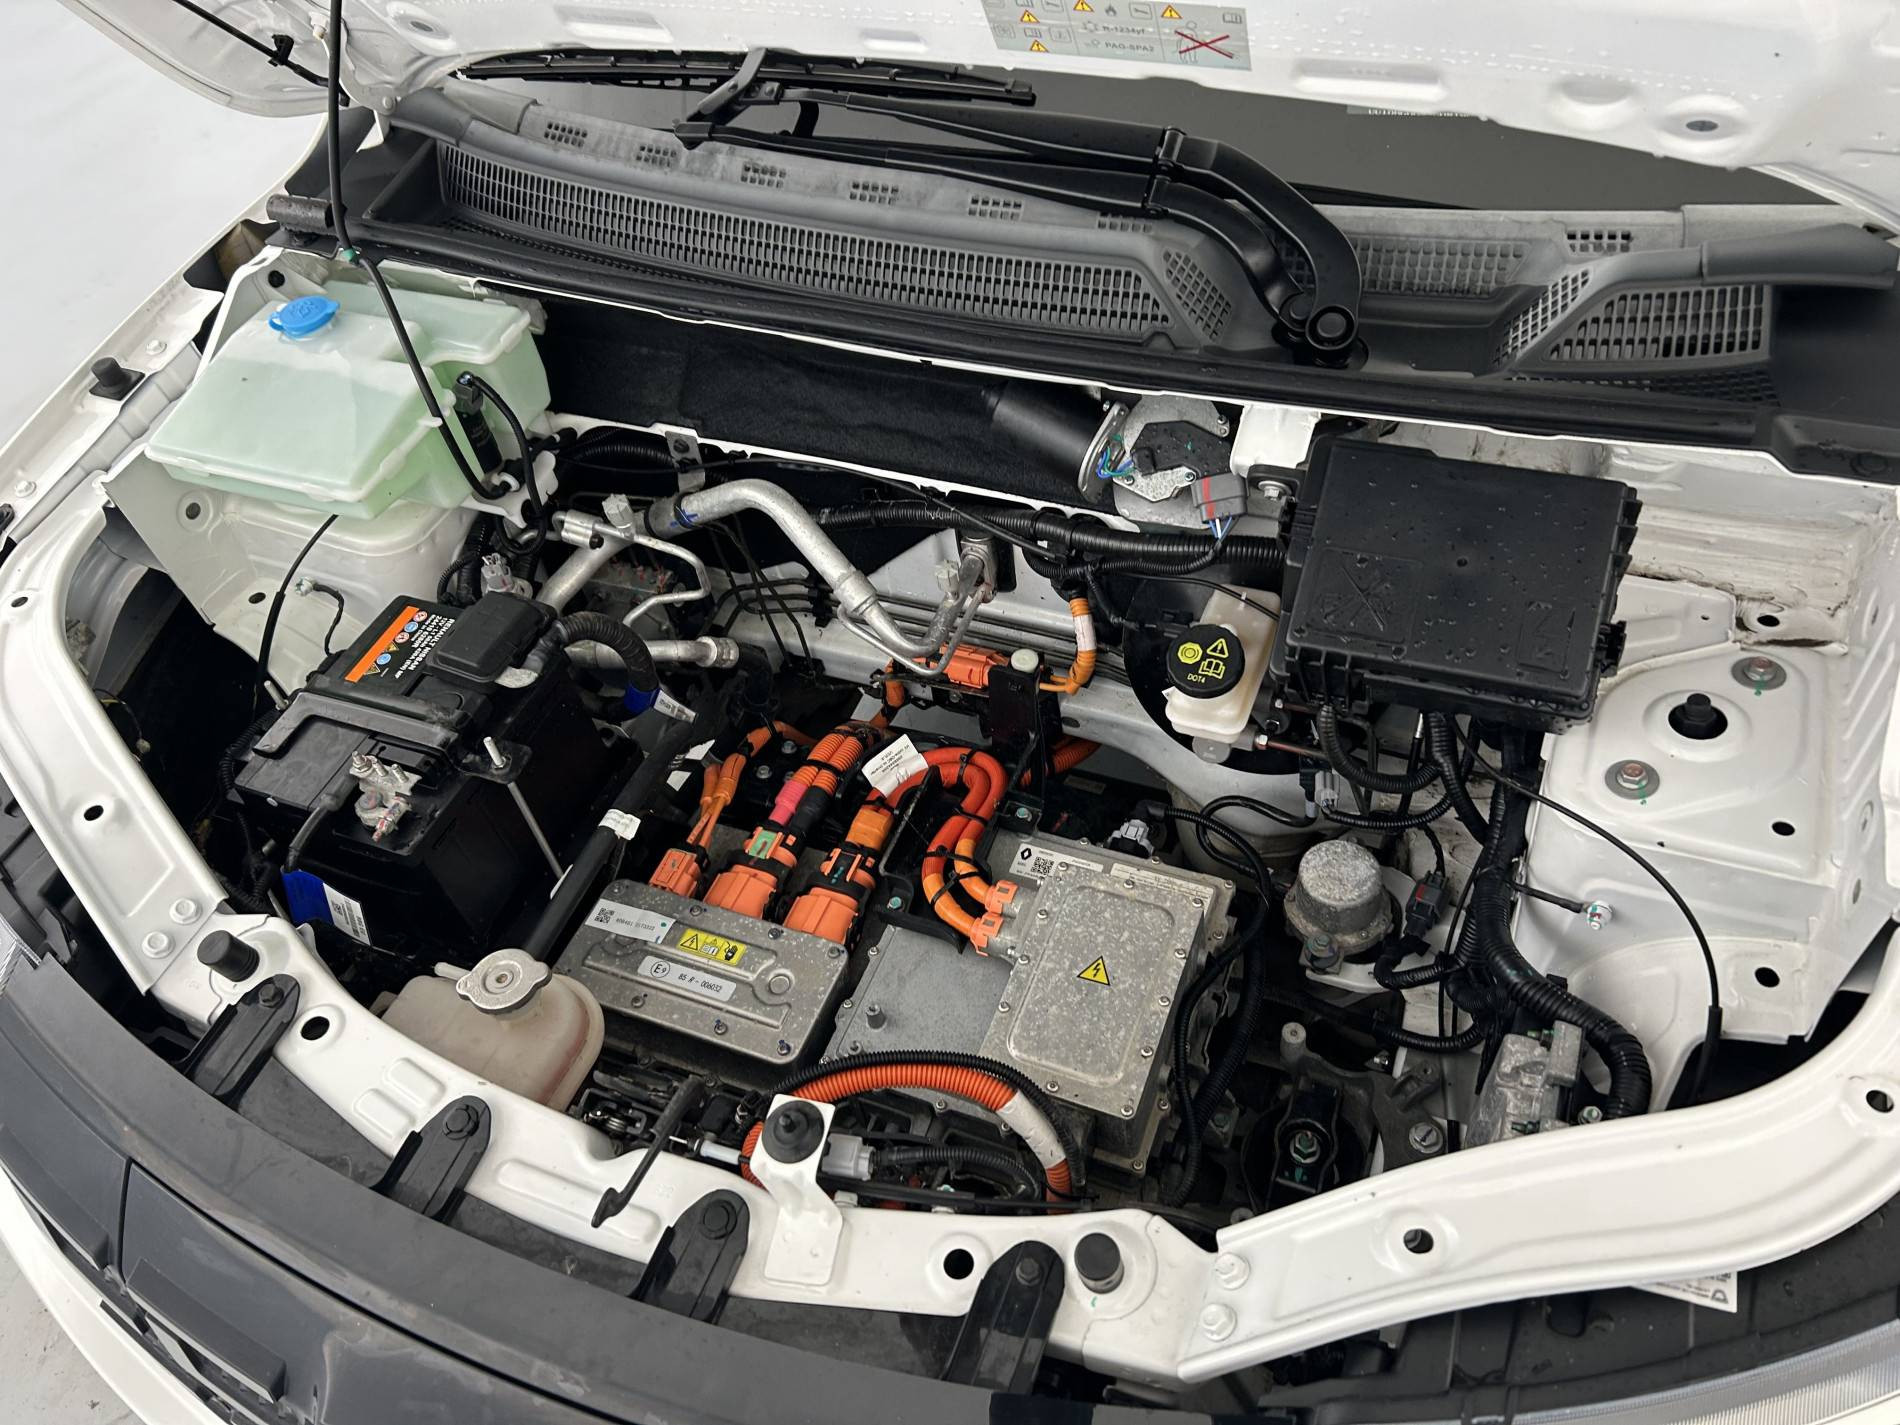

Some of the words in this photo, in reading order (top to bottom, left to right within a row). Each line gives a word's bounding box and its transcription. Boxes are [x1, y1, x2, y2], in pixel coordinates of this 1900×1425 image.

[429, 618, 455, 647] RENAULT
[439, 617, 448, 626] 12V
[408, 647, 431, 670] NISSAN
